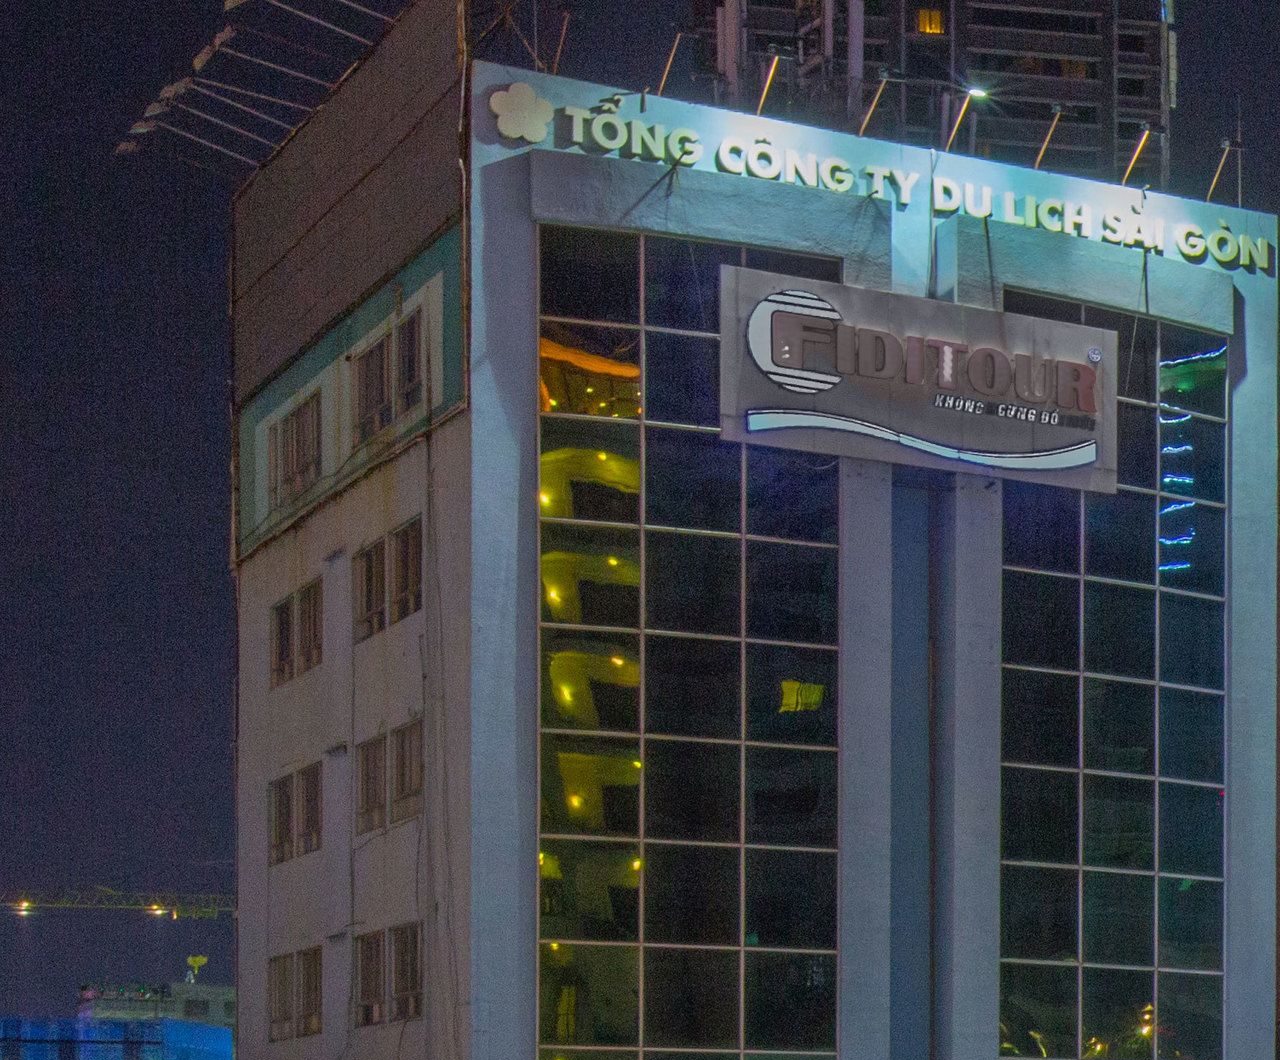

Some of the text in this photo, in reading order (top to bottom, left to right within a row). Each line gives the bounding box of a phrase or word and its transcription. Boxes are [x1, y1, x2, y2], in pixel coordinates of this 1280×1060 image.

[563, 95, 704, 167] TỔNG
[717, 136, 854, 193] CÔNG
[864, 166, 920, 209] TY
[932, 177, 992, 219] DU
[1176, 218, 1269, 270] GÒN
[770, 309, 1098, 415] FIDITOUR
